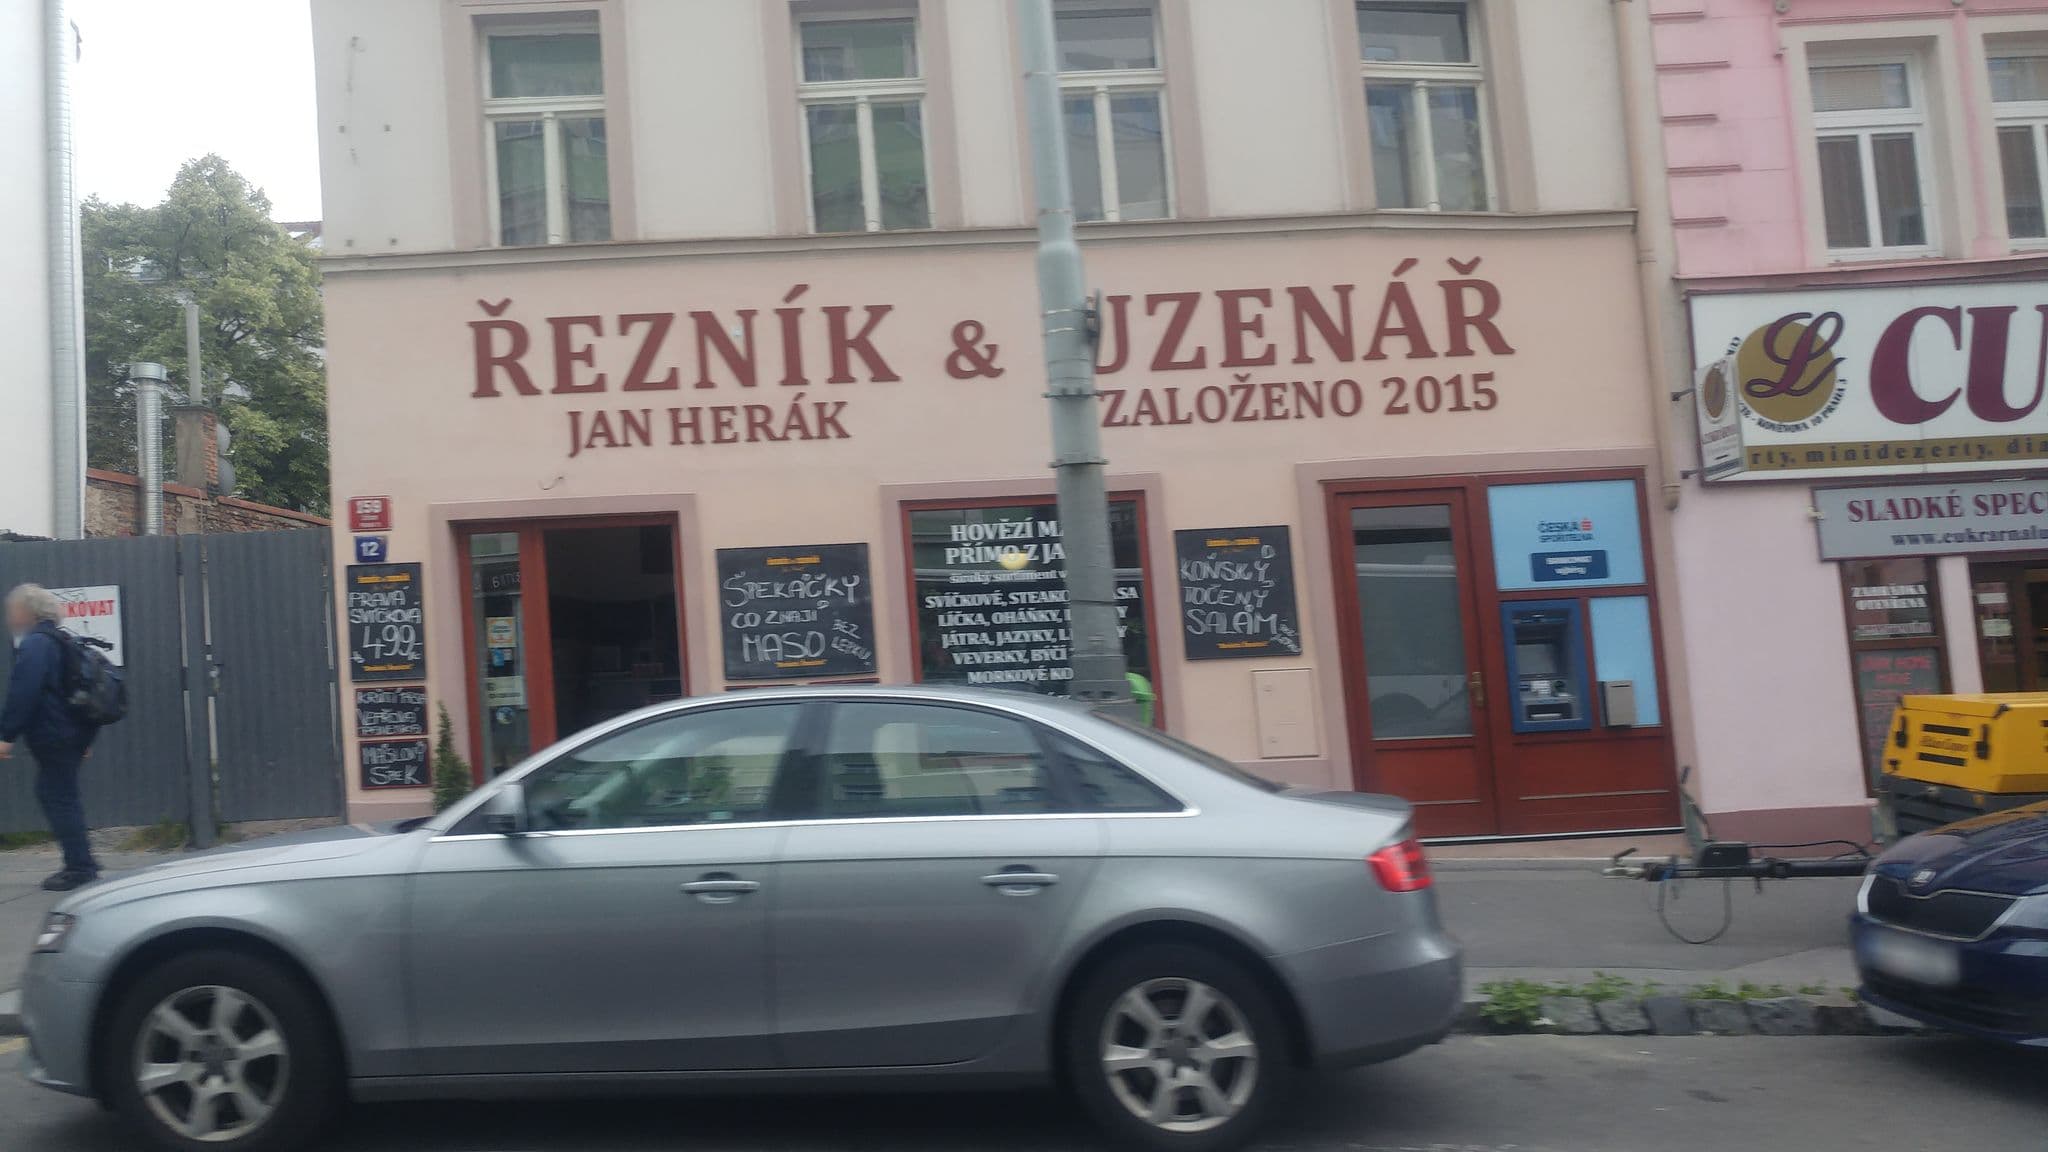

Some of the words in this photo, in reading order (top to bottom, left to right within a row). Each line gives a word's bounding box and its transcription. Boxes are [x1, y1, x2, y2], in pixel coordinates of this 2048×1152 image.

[467, 284, 900, 398] ŘEZNÍK
[945, 319, 1004, 379] &
[1869, 305, 2048, 424] CU
[1100, 374, 1362, 427] ZALOŽENO
[1382, 371, 1497, 415] 2015
[567, 408, 652, 457] JAN
[669, 393, 850, 446] HERÁK
[1847, 489, 1963, 522] SLADKÉ
[1972, 491, 2048, 516] SPEC
[951, 518, 1034, 541] HOVĚZÍ
[1038, 520, 1064, 537] M
[360, 541, 380, 557] 12
[944, 542, 1019, 565] PŘÍMO
[1023, 544, 1039, 561] Z
[60, 600, 114, 618] KOVAT
[742, 630, 826, 662] MASO
[941, 630, 995, 649] JÁTRA,
[996, 629, 1058, 646] JAZYKY,
[952, 650, 1030, 665] VEVERKY,
